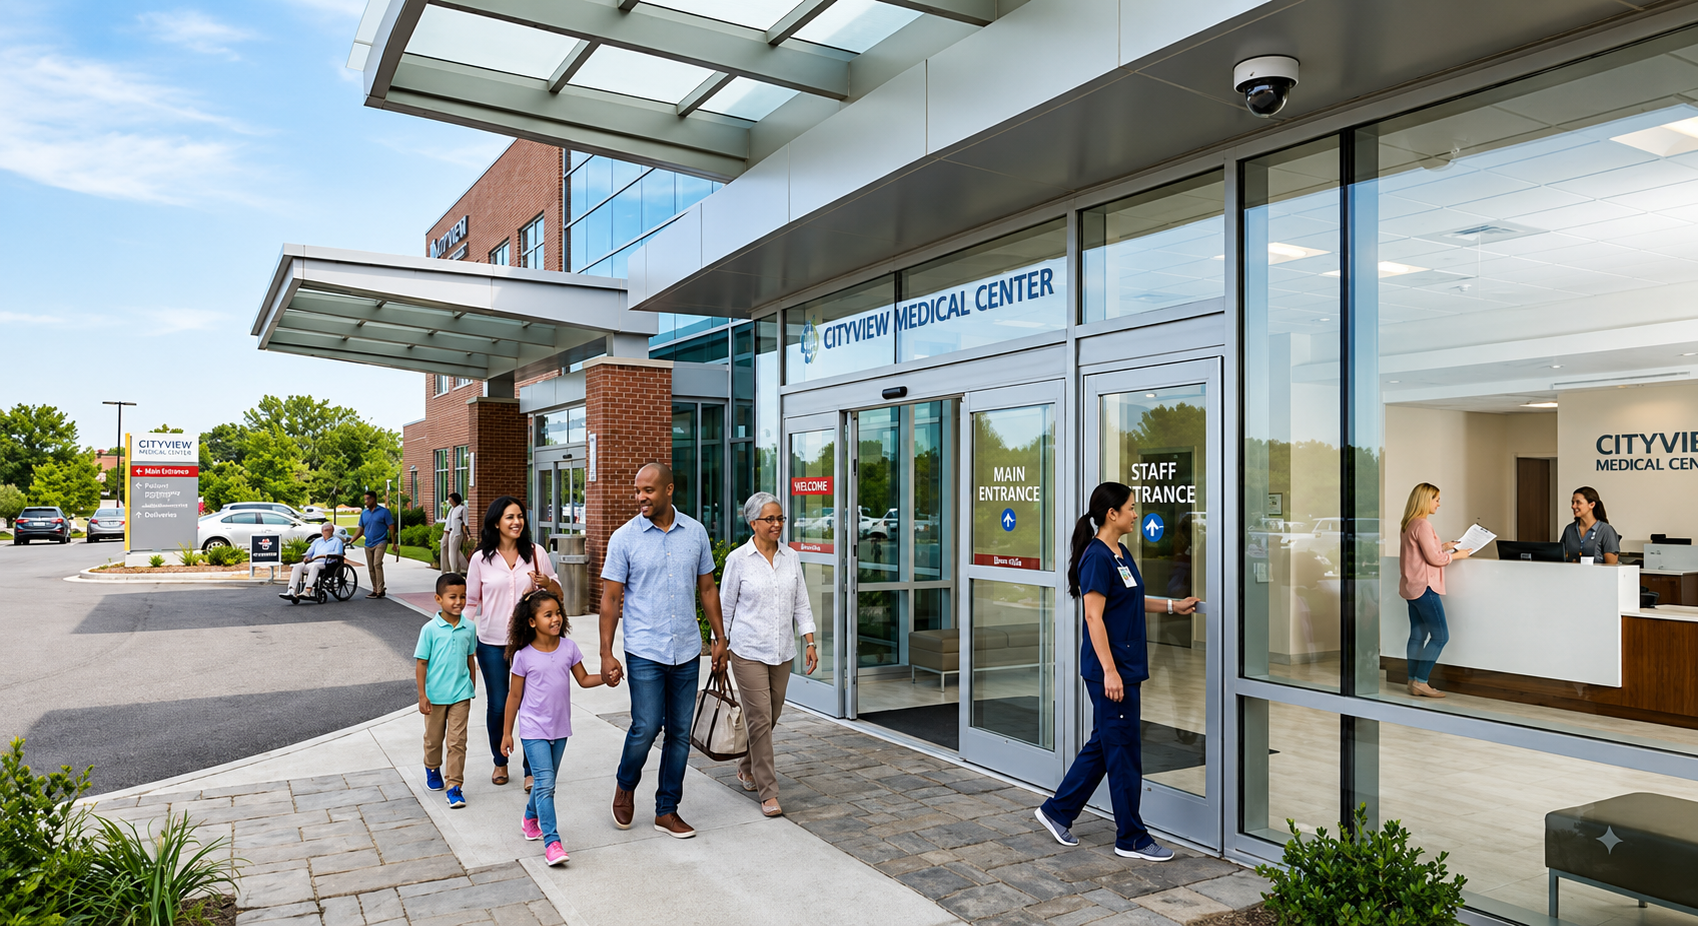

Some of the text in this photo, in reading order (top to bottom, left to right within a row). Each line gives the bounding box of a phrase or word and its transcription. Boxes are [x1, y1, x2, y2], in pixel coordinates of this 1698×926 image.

[823, 267, 1055, 350] CITYVIEW MEDICAL CENTER
[138, 439, 193, 449] CITYVIEW
[144, 467, 161, 475] Main
[1131, 462, 1177, 481] STAFF
[1596, 458, 1665, 471] MEDICAL
[993, 466, 1025, 482] MAIN
[794, 480, 828, 492] WELCOME
[979, 486, 1040, 502] ENTRANCE
[1129, 485, 1196, 504] TRANCE
